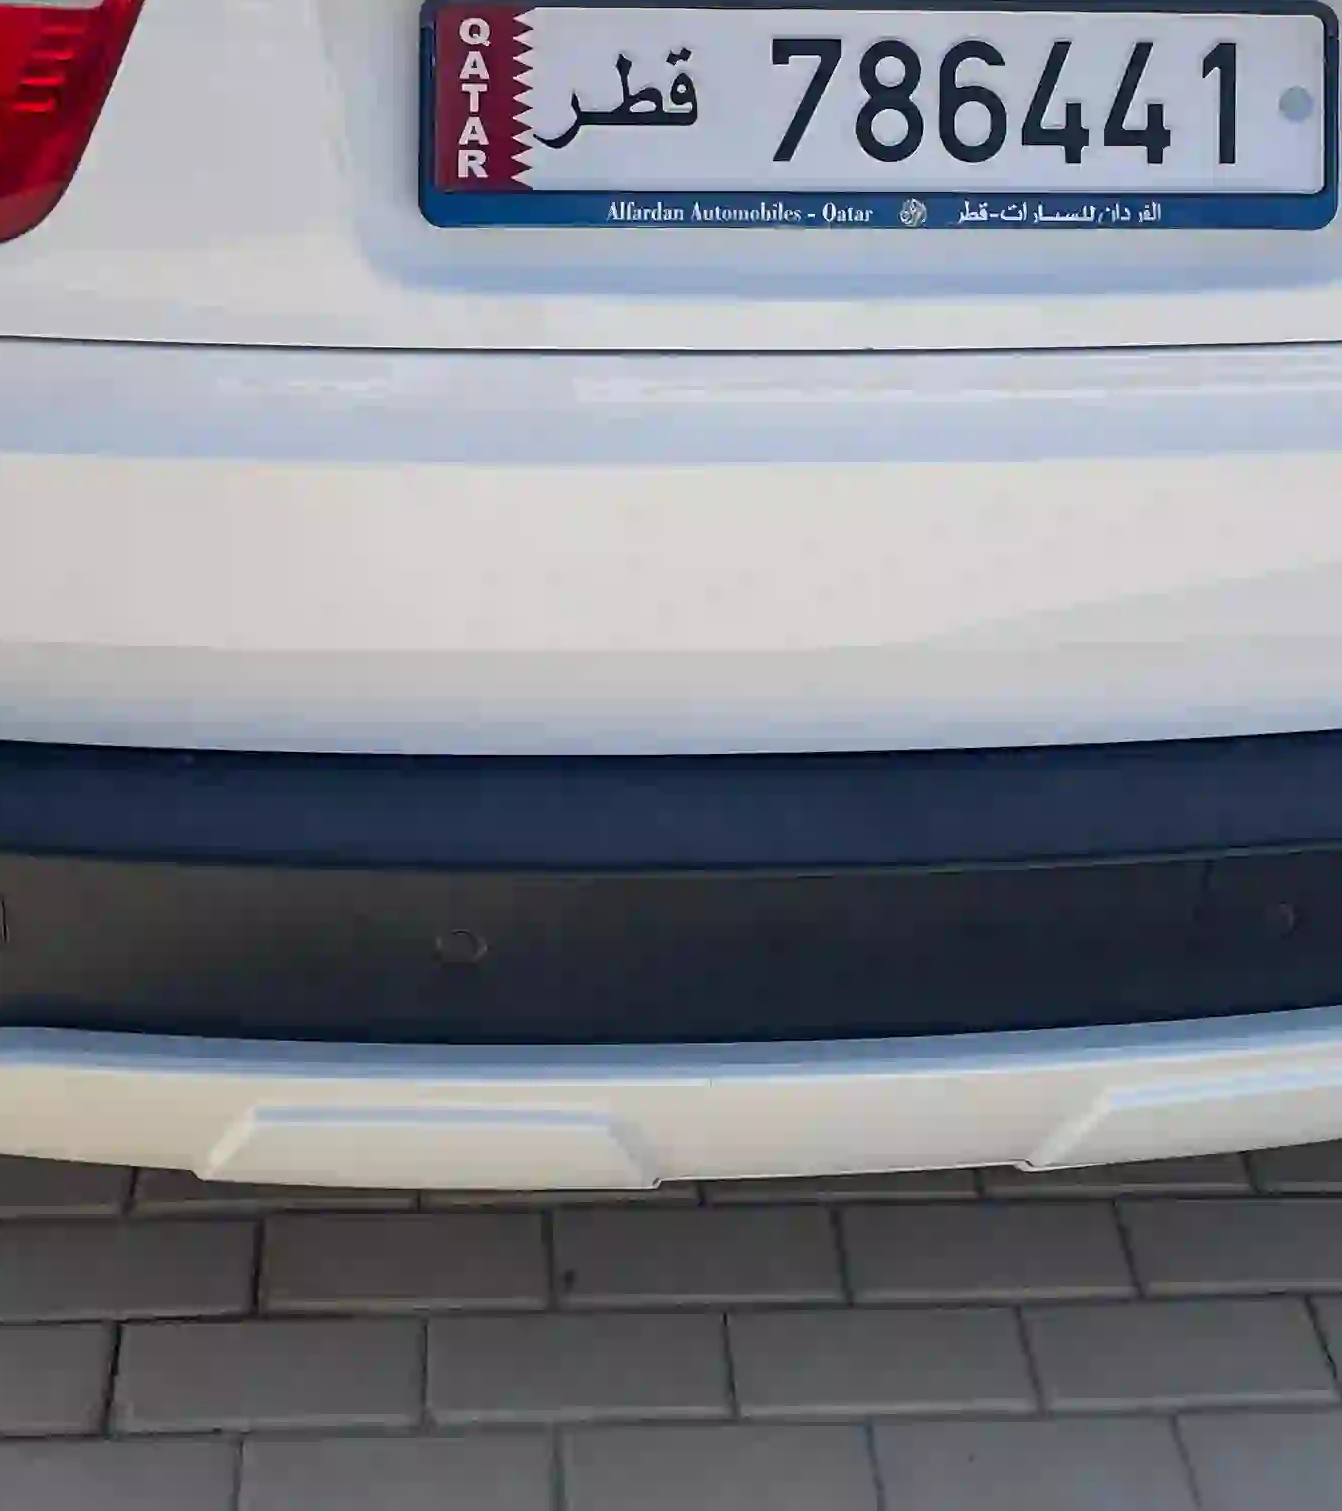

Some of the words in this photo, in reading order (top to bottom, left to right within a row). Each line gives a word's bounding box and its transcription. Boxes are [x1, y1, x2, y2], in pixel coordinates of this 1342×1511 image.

[457, 17, 491, 179] QATAR
[532, 47, 699, 150] قطر
[771, 38, 1237, 166] 786441
[606, 200, 684, 223] Alfardan
[689, 201, 802, 223] Automobiles
[821, 202, 875, 223] Qatar
